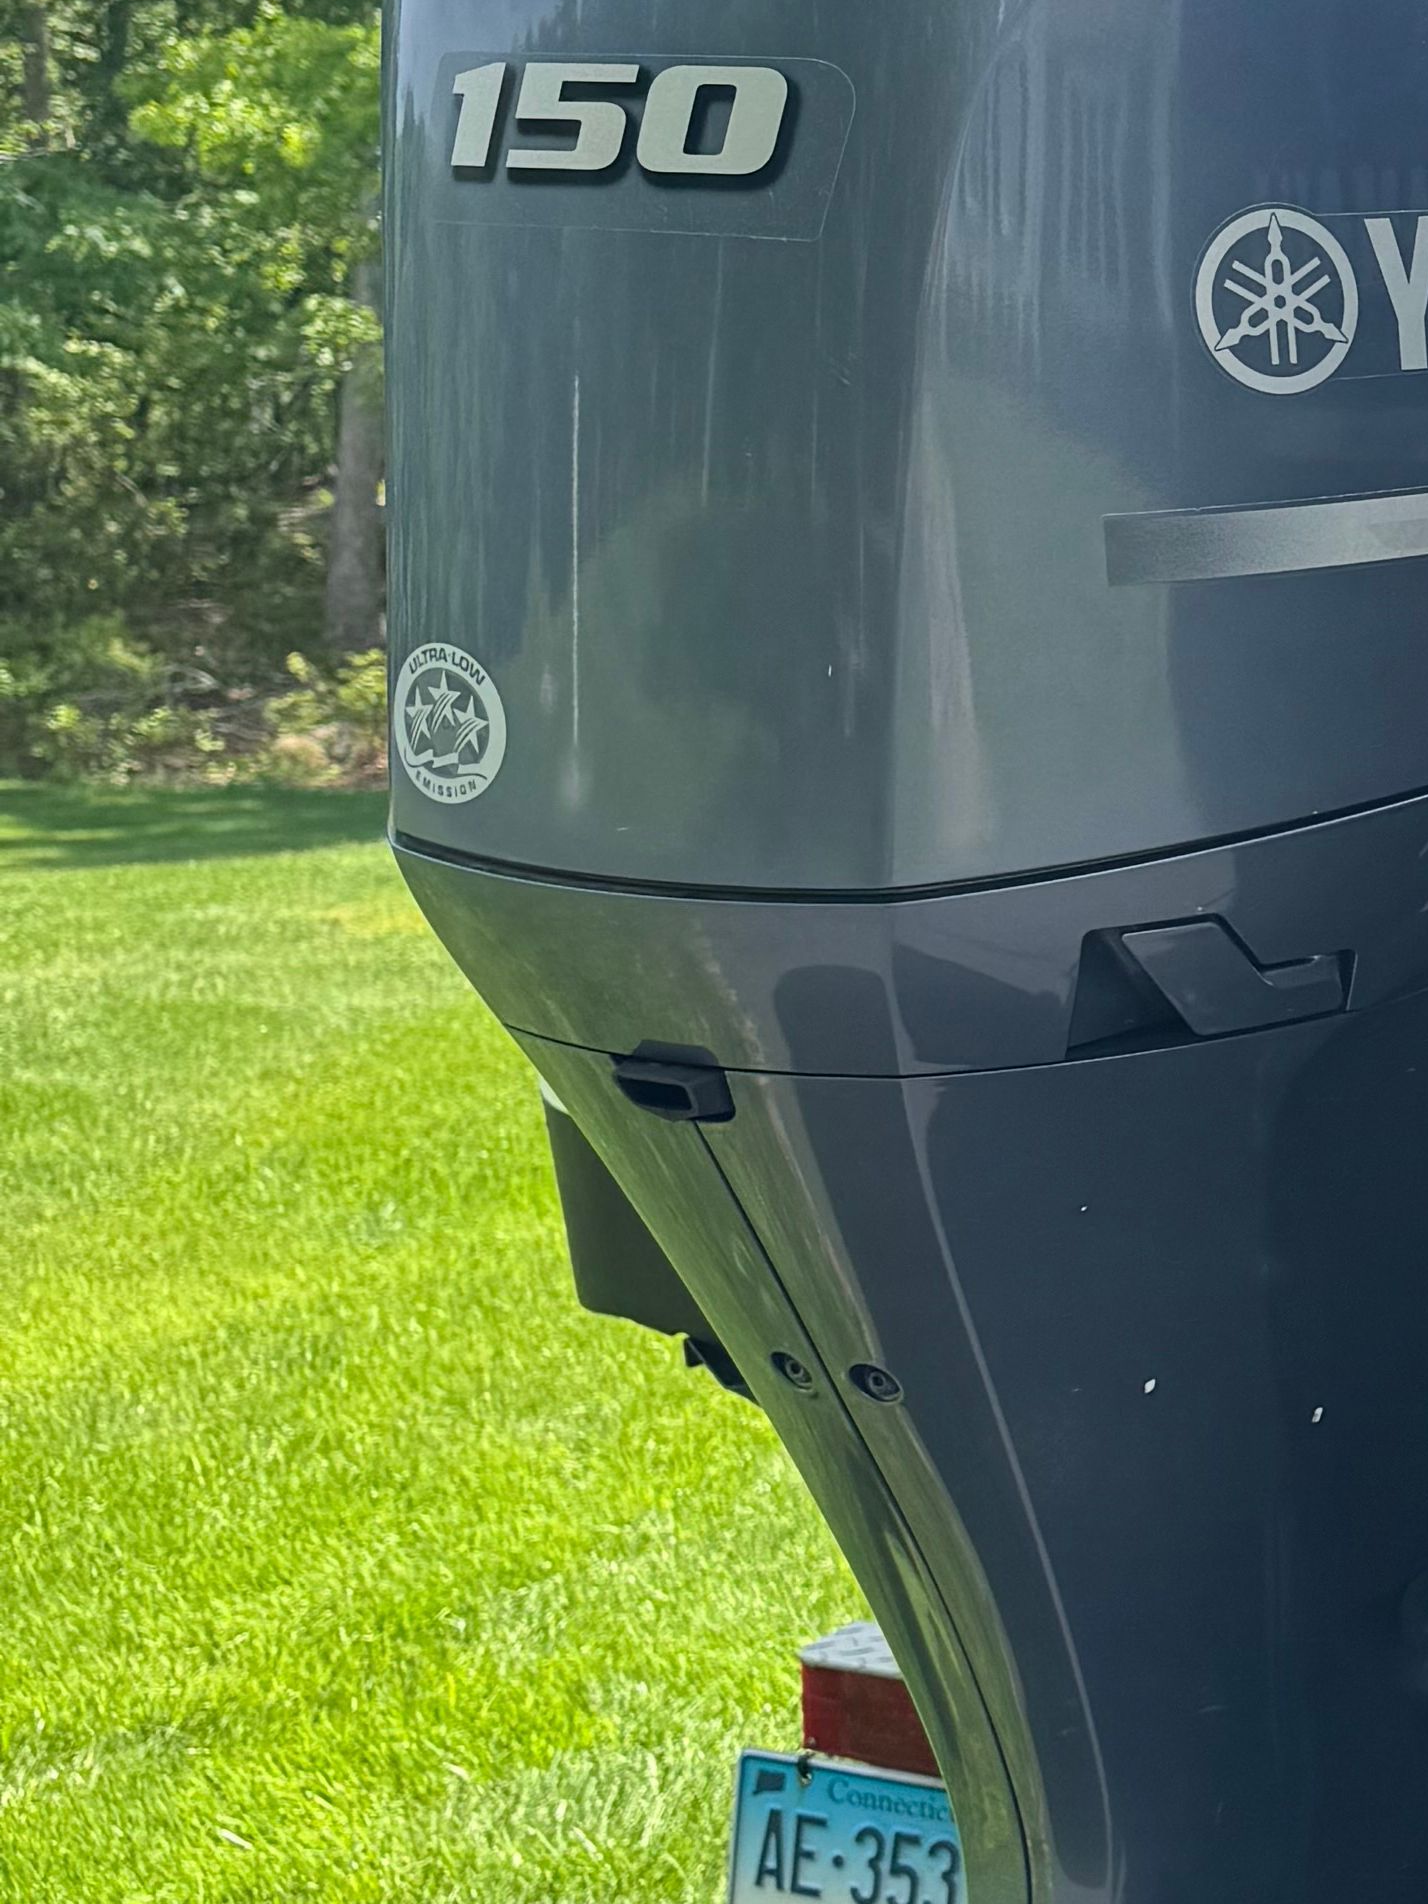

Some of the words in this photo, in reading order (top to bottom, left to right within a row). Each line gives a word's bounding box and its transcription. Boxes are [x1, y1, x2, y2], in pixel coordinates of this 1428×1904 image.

[449, 61, 790, 176] 150
[415, 769, 477, 798] EMISSION
[826, 1776, 955, 1824] Connectic
